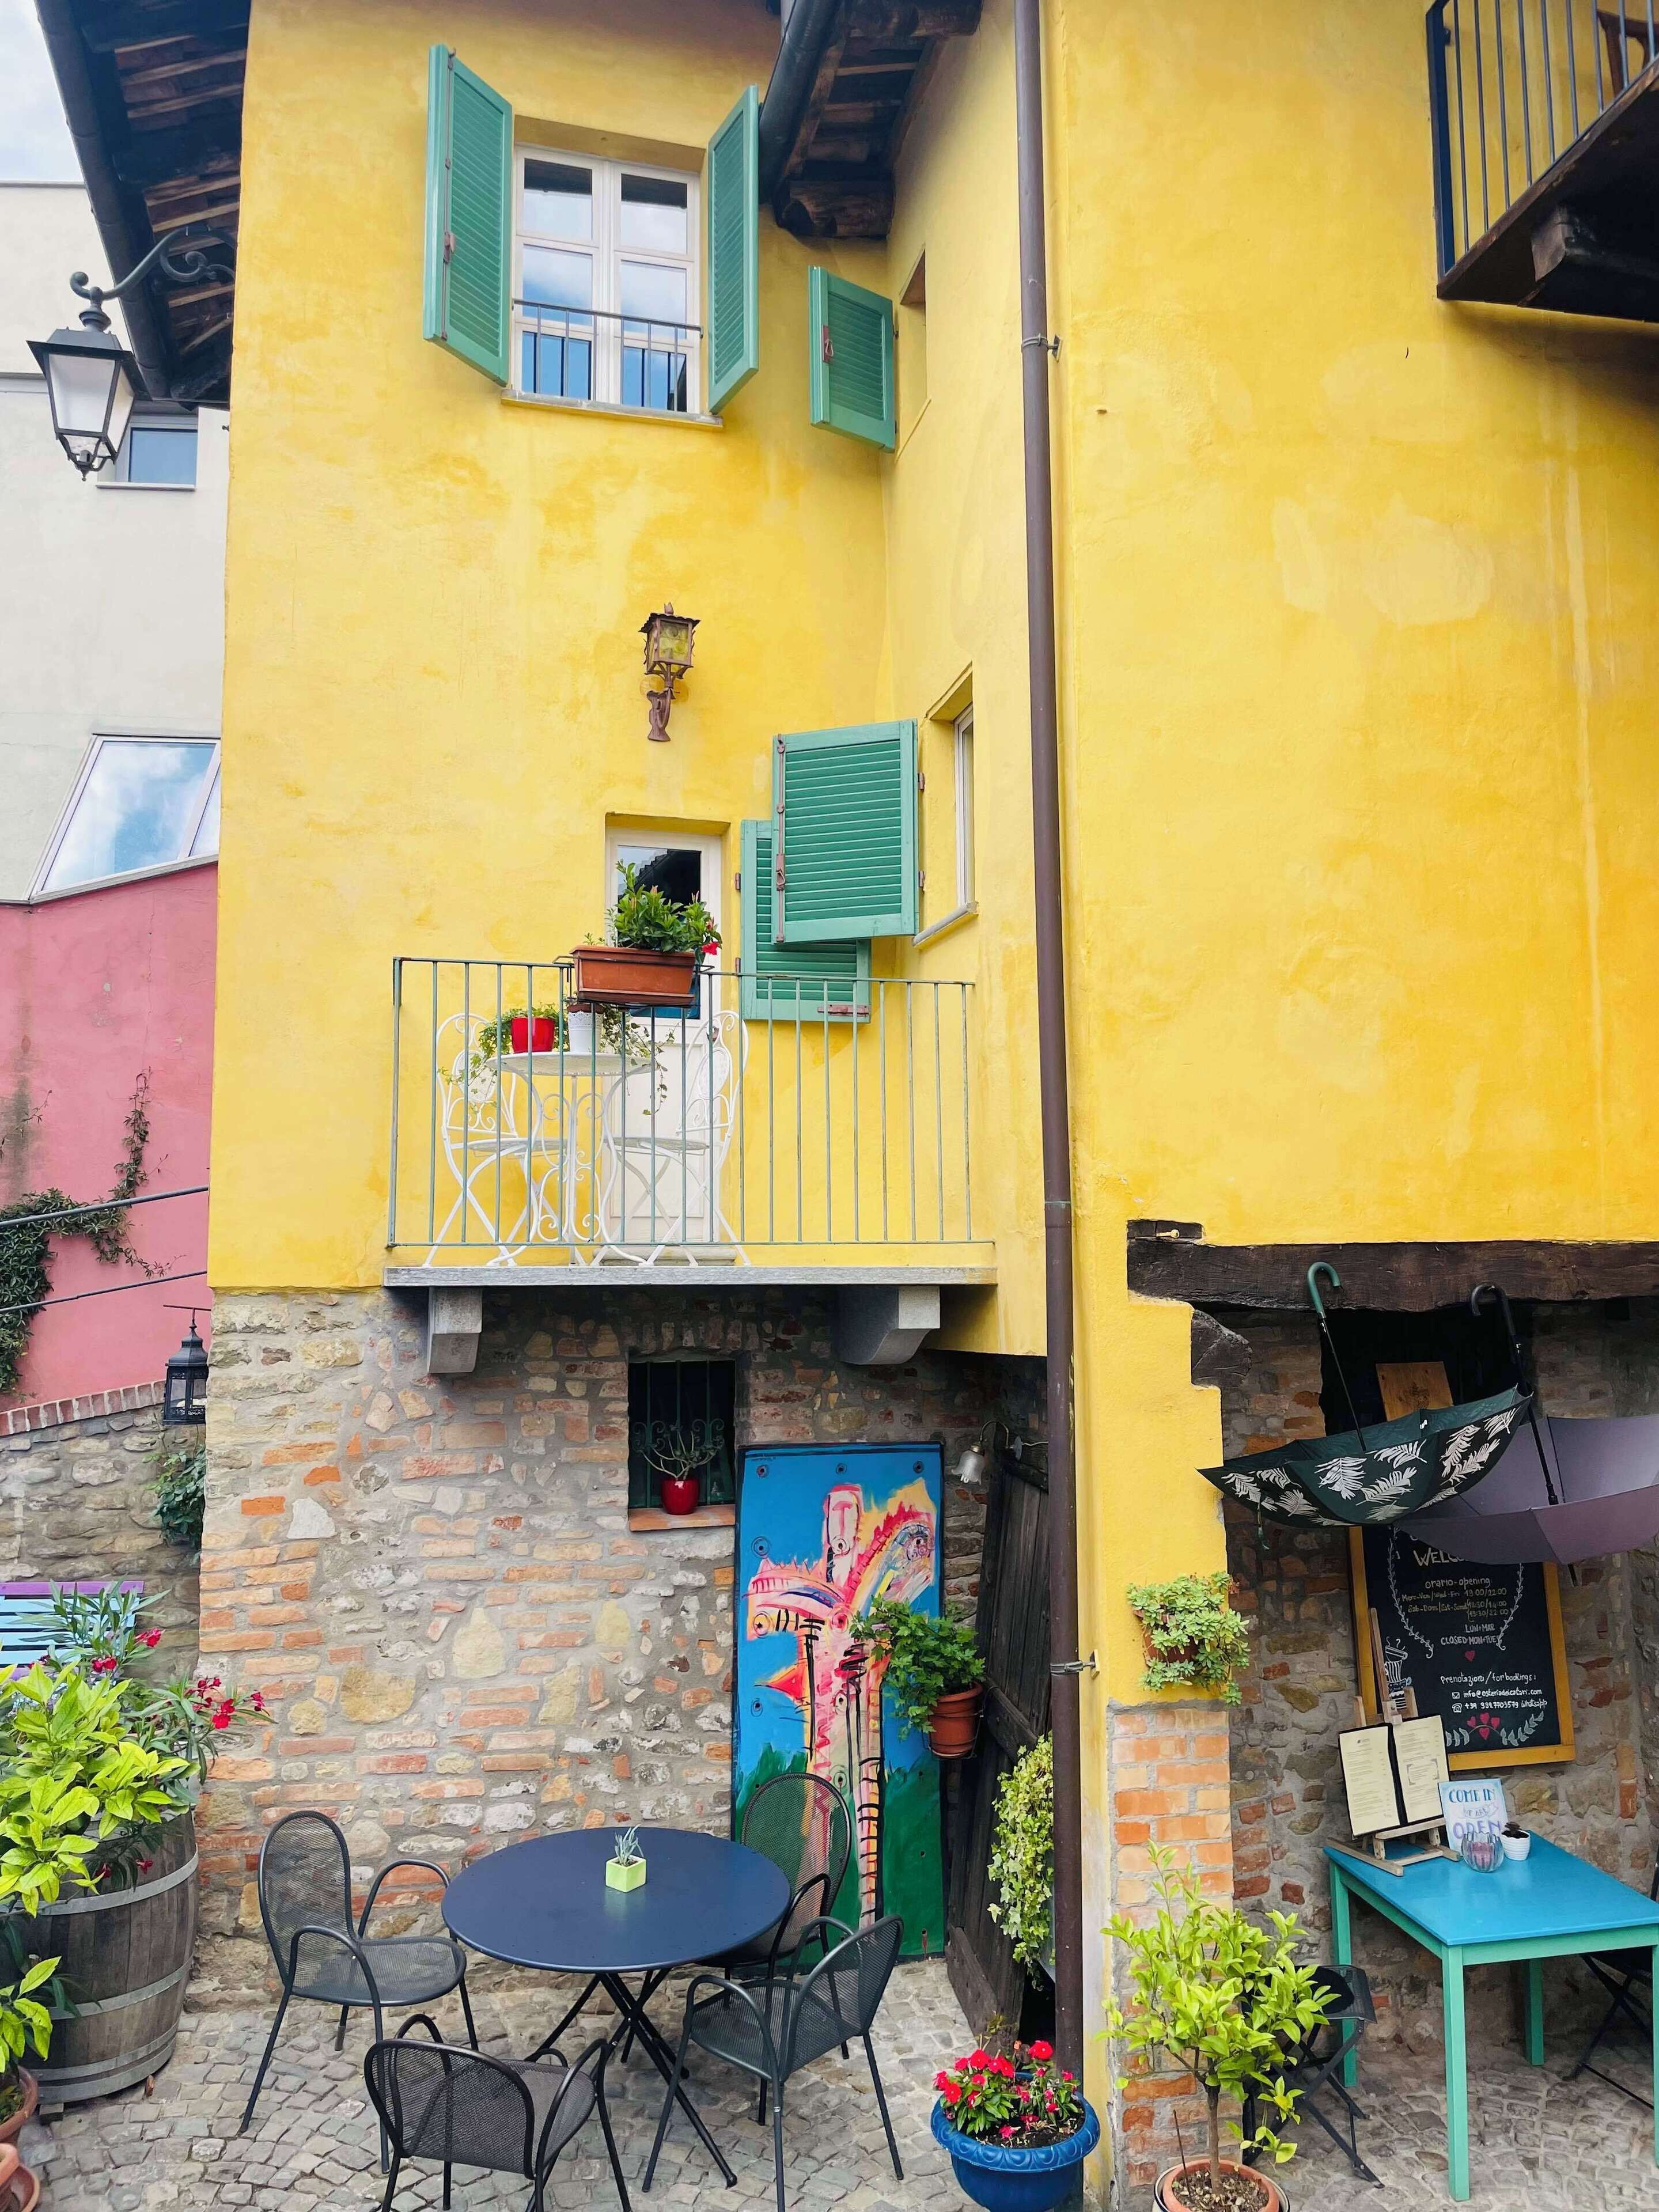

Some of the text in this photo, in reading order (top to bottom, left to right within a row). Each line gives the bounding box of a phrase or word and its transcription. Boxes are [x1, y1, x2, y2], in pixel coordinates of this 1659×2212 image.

[1440, 1635, 1468, 1646] CLOSED
[1448, 1788, 1480, 1803] COME
[1483, 1787, 1496, 1801] IN
[1453, 1820, 1501, 1839] OPEN
